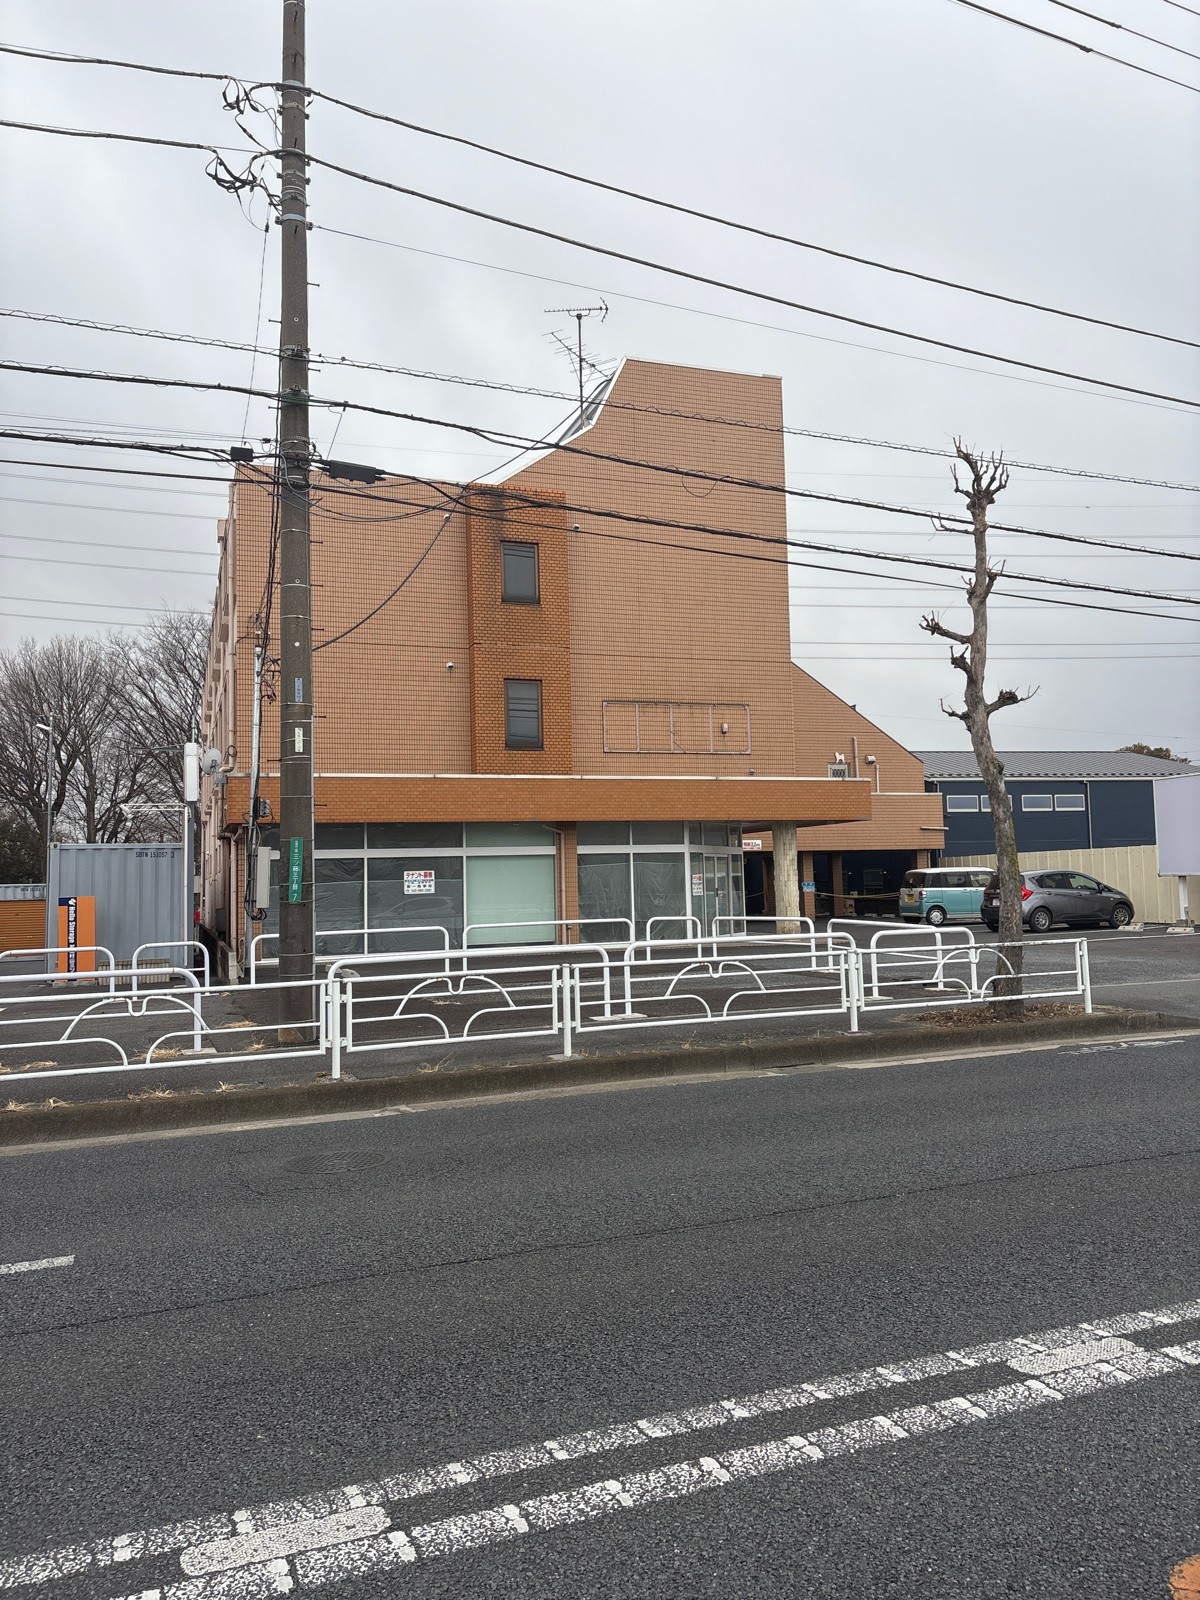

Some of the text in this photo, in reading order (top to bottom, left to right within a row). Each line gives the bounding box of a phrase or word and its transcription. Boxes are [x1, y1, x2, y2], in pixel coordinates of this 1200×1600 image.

[292, 893, 297, 902] 7
[68, 906, 76, 921] Hello
[68, 921, 76, 944] Storage
